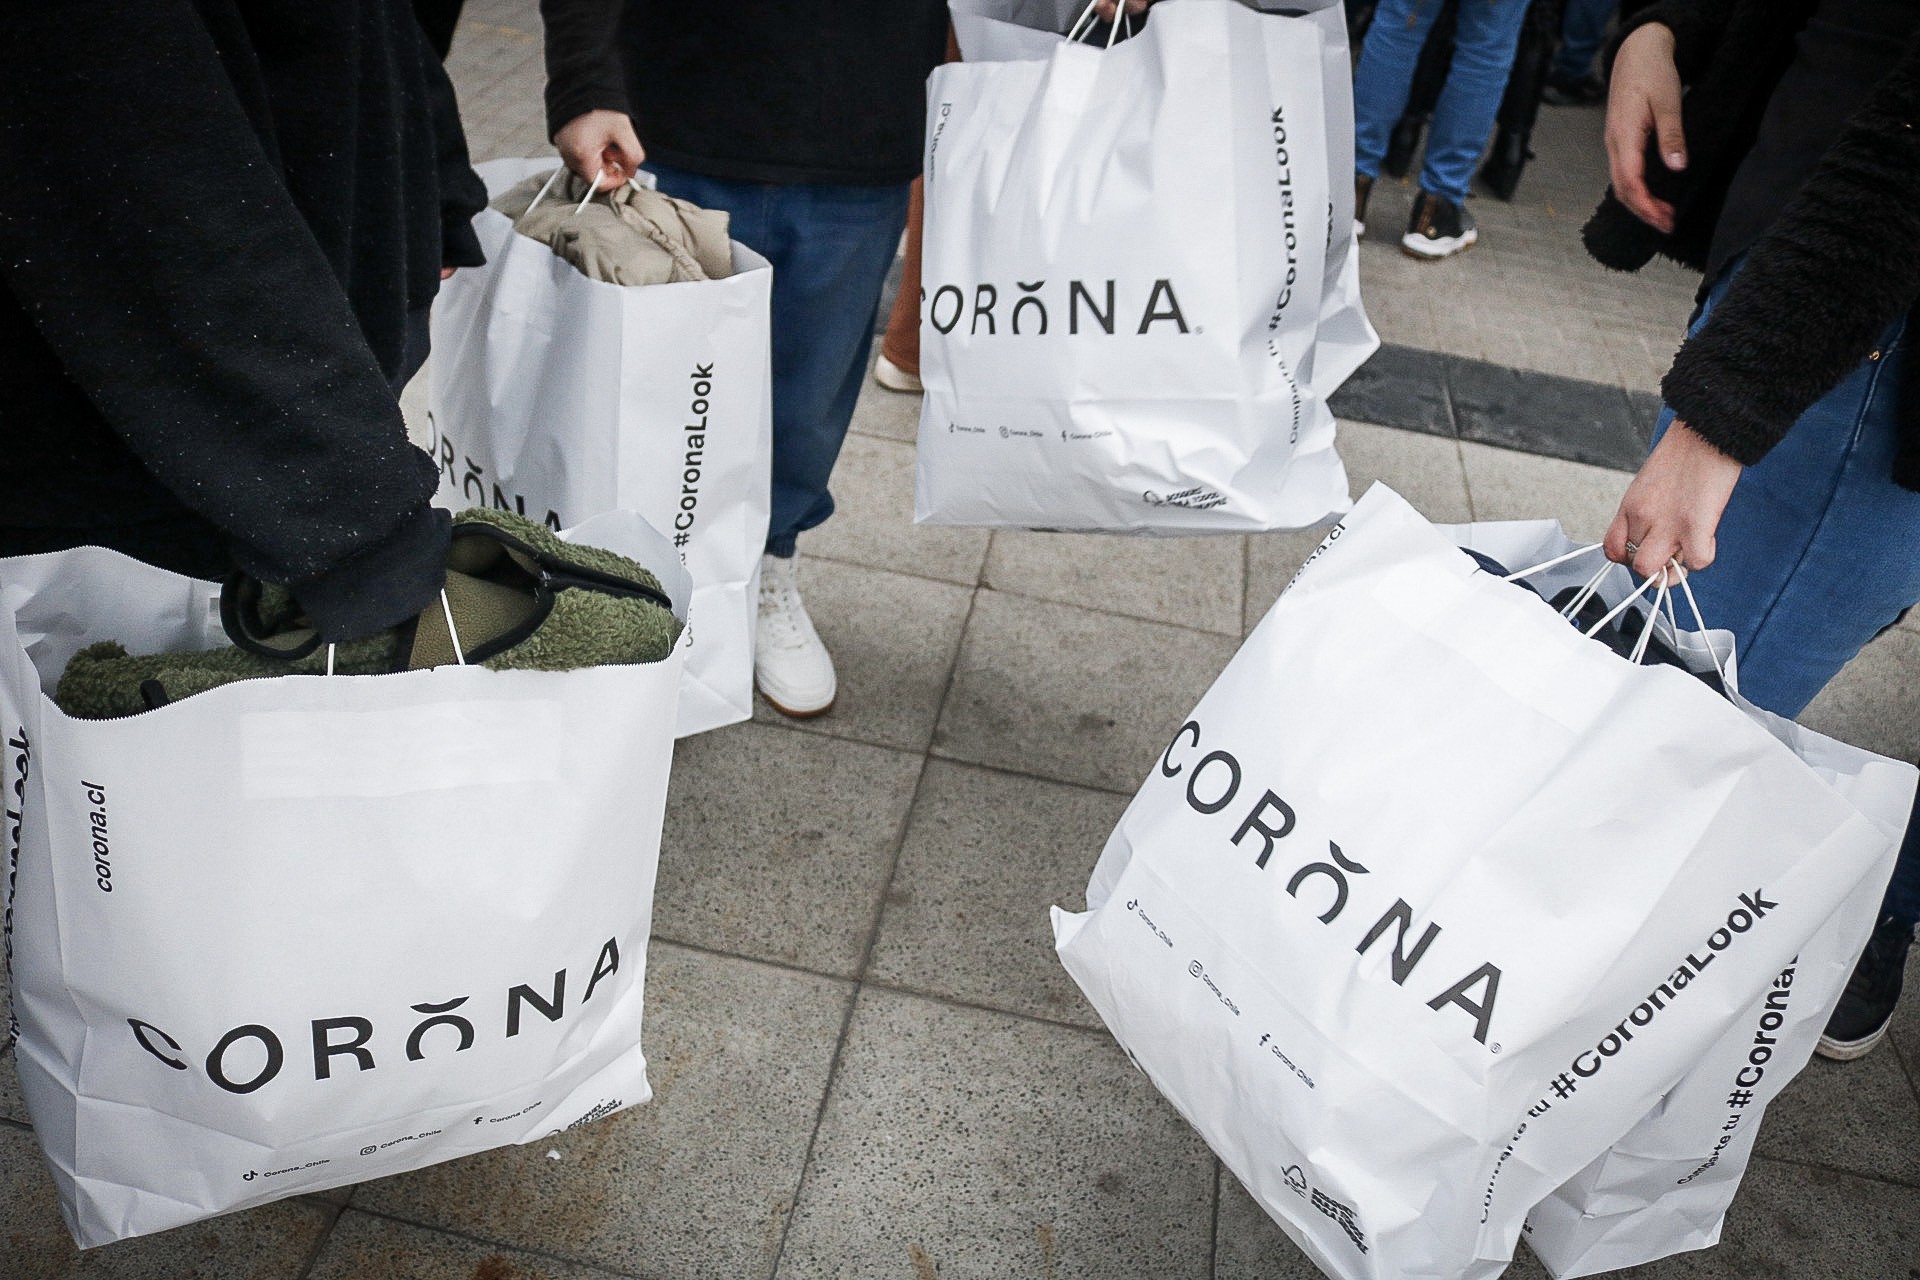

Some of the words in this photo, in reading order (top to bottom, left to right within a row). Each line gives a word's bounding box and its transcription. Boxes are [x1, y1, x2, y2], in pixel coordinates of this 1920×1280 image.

[1268, 105, 1297, 331] #CoronaLook
[673, 362, 714, 548] #CoronaLook
[81, 779, 114, 893] corona.cl
[1549, 887, 1779, 1100] #CoronaLook
[1726, 953, 1799, 1108] #Corona
[263, 1158, 331, 1178] Corona_Chile
[380, 1129, 442, 1149] Corona_Chile
[489, 1111, 521, 1124] Corona
[522, 1101, 542, 1115] Chile
[1721, 1114, 1741, 1132] tu
